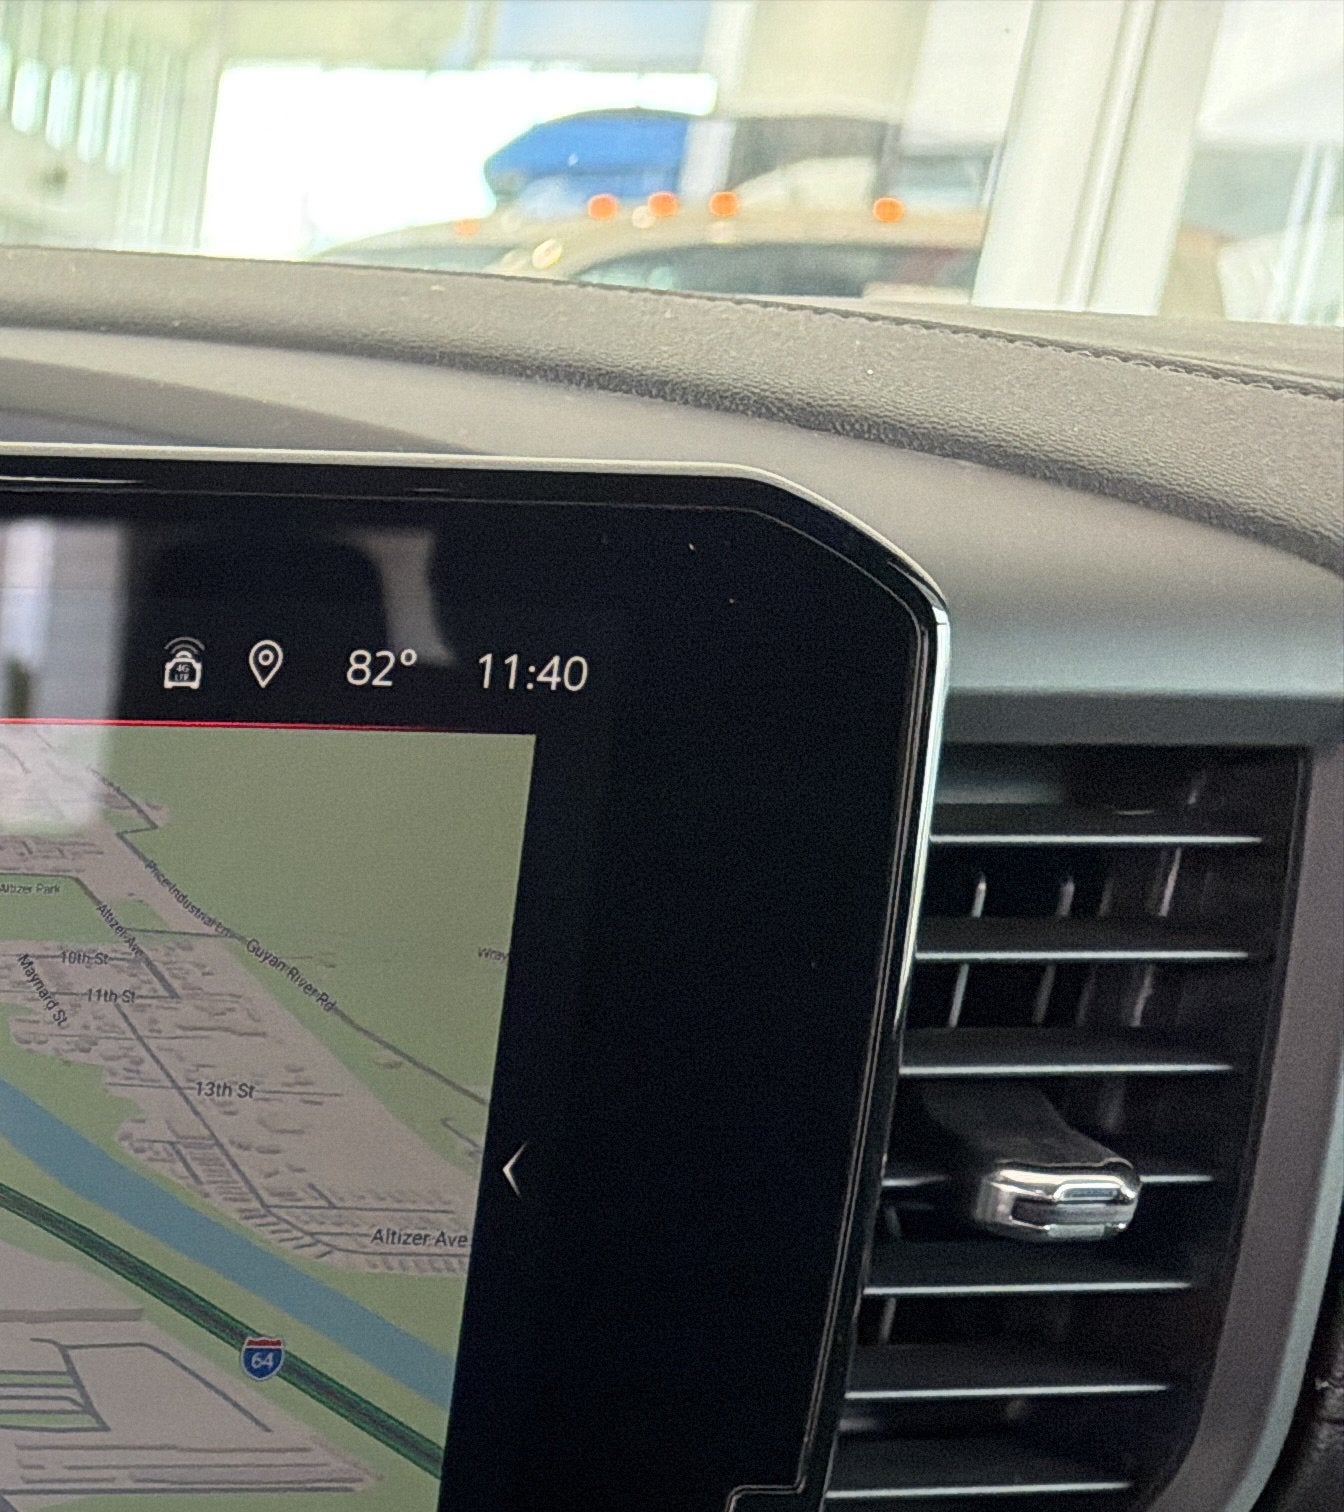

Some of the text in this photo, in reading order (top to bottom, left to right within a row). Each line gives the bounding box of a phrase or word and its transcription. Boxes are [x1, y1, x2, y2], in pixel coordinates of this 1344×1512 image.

[346, 649, 418, 688] 82°
[478, 653, 589, 691] 11:40
[35, 883, 61, 894] Park
[62, 951, 110, 966] 10th St
[245, 938, 338, 1014] Guyan River Rd
[17, 953, 69, 1027] Maynard St
[87, 988, 137, 1004] 11th St
[195, 1080, 256, 1100] 13th St
[370, 1228, 469, 1247] Altizer Ave
[250, 1352, 275, 1369] 64
